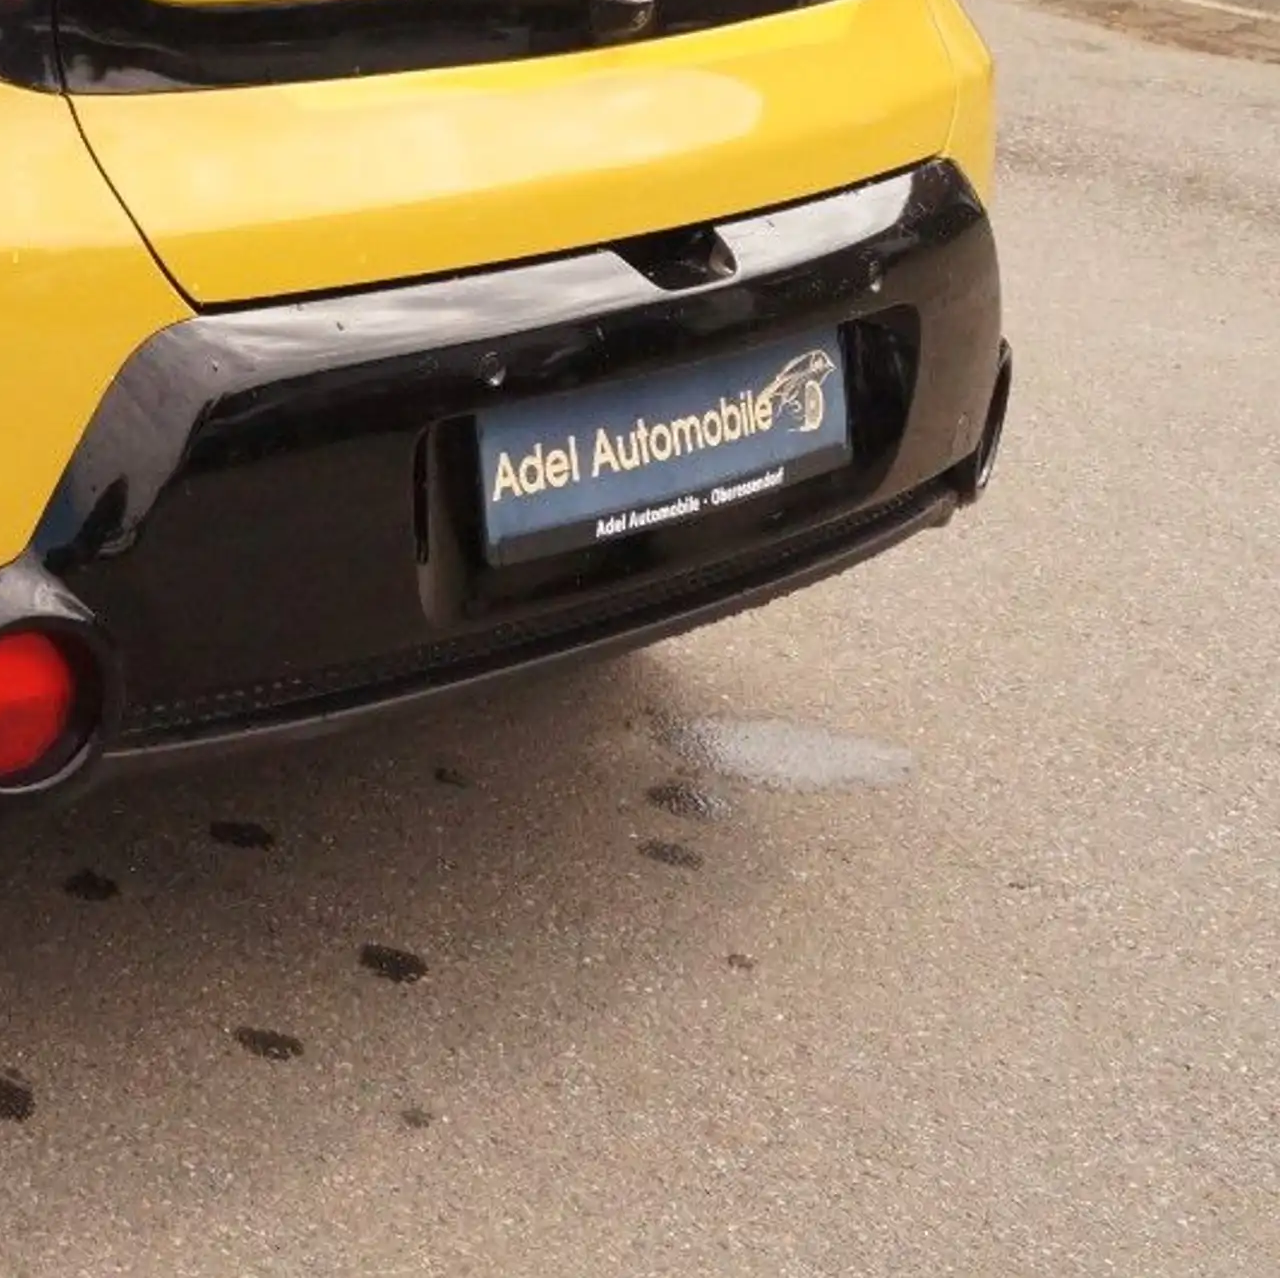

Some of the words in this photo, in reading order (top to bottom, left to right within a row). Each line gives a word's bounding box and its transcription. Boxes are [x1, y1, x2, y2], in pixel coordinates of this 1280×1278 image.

[493, 435, 580, 502] Adel
[591, 390, 773, 478] Automobile
[596, 512, 627, 538] Adel
[628, 494, 701, 529] Automobile
